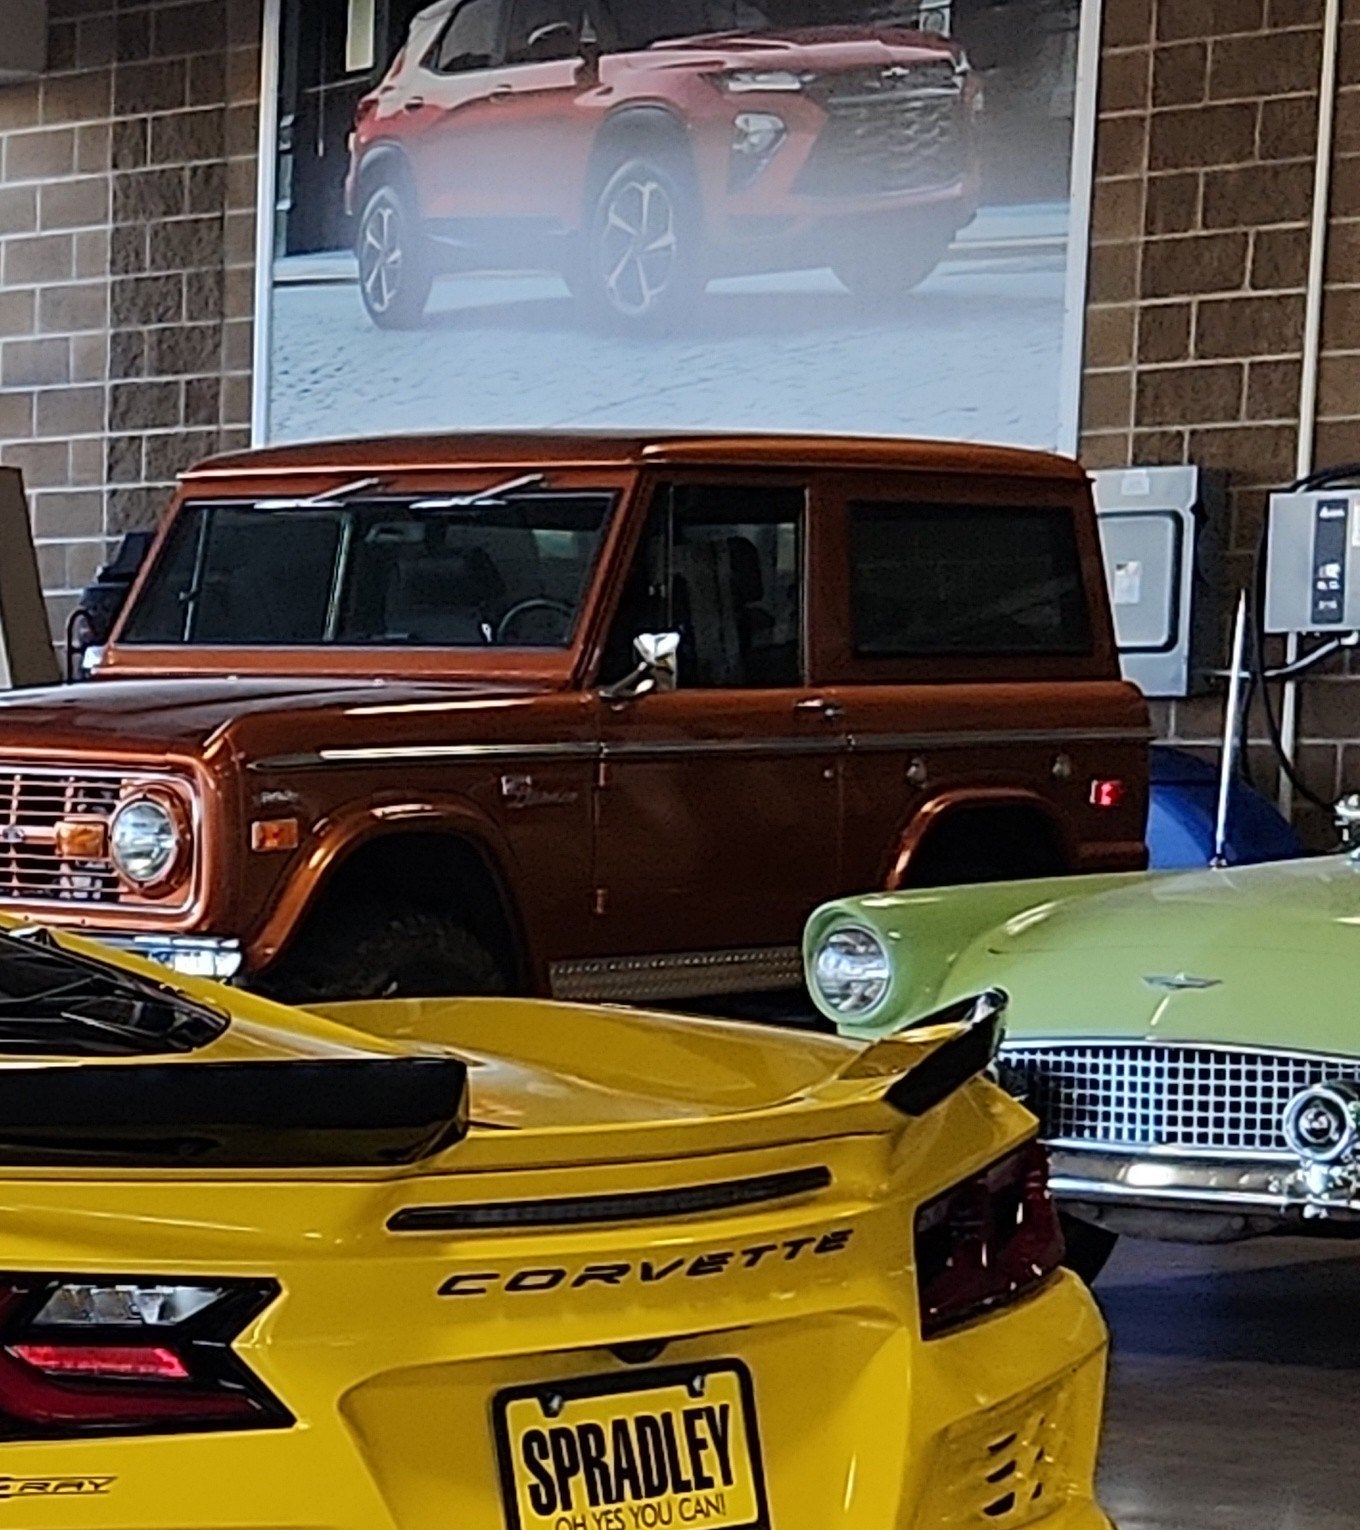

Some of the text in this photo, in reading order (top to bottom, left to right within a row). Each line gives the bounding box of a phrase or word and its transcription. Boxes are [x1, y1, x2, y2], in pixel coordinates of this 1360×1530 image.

[437, 1229, 855, 1297] CORVETTE
[521, 1404, 733, 1516] SPRADLEY
[630, 1500, 673, 1530] YOU
[679, 1493, 726, 1522] CAN!
